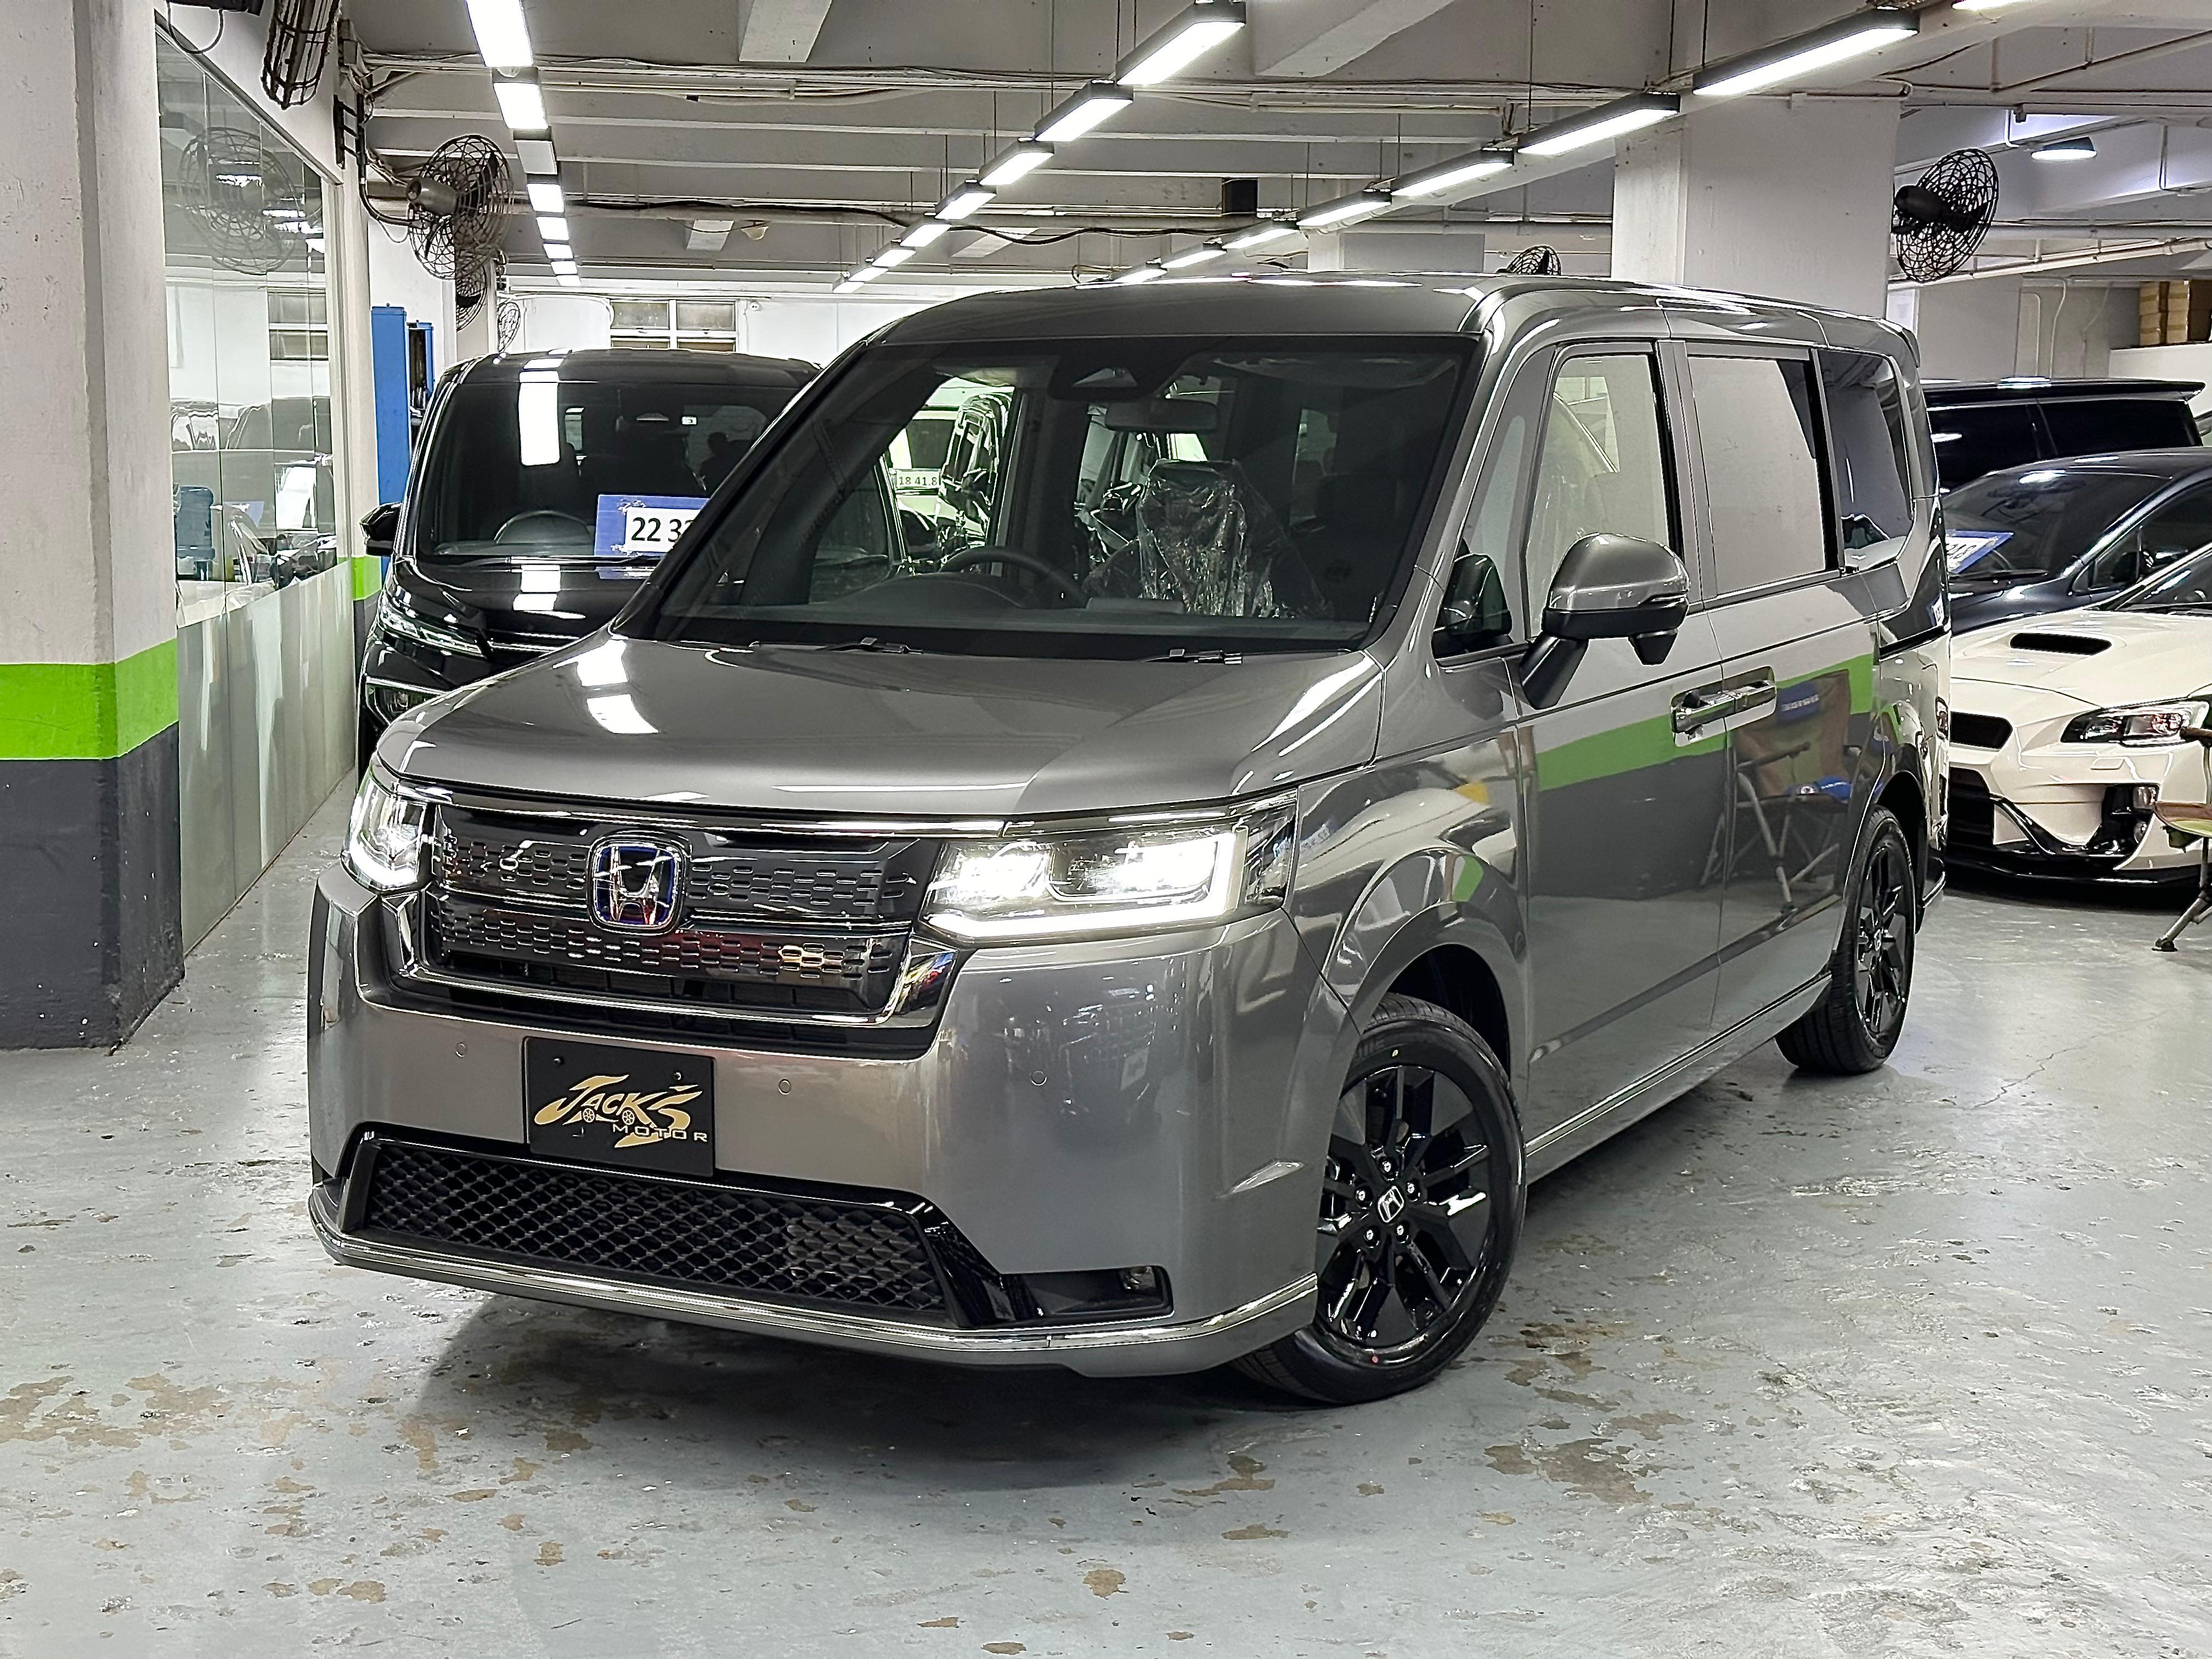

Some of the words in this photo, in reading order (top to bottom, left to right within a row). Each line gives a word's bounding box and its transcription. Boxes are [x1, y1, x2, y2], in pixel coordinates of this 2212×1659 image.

[899, 476, 911, 486] 18
[915, 476, 938, 486] 41.8
[631, 517, 661, 542] 22
[668, 518, 696, 543] 3
[612, 1123, 708, 1143] MOTOR
